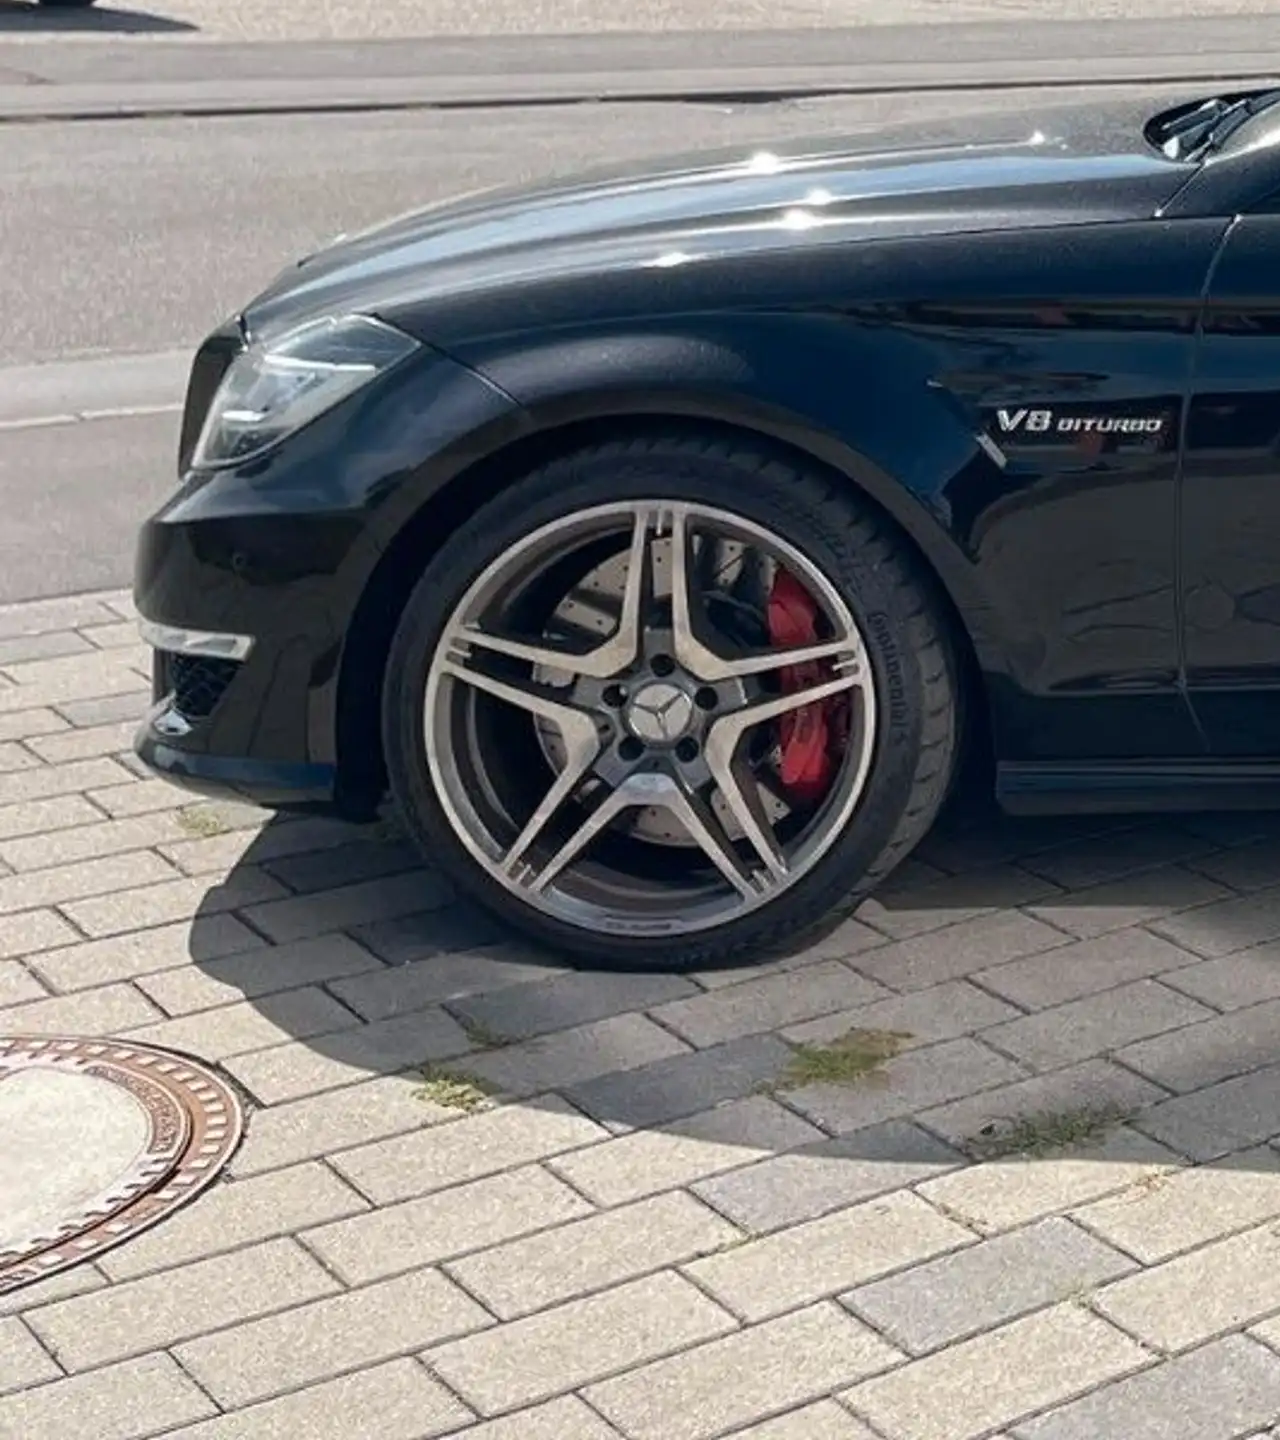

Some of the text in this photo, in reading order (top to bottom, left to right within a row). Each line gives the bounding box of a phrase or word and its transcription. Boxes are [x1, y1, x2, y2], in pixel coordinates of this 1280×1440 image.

[997, 408, 1164, 433] V8 BITURBO
[866, 612, 908, 730] Continental
